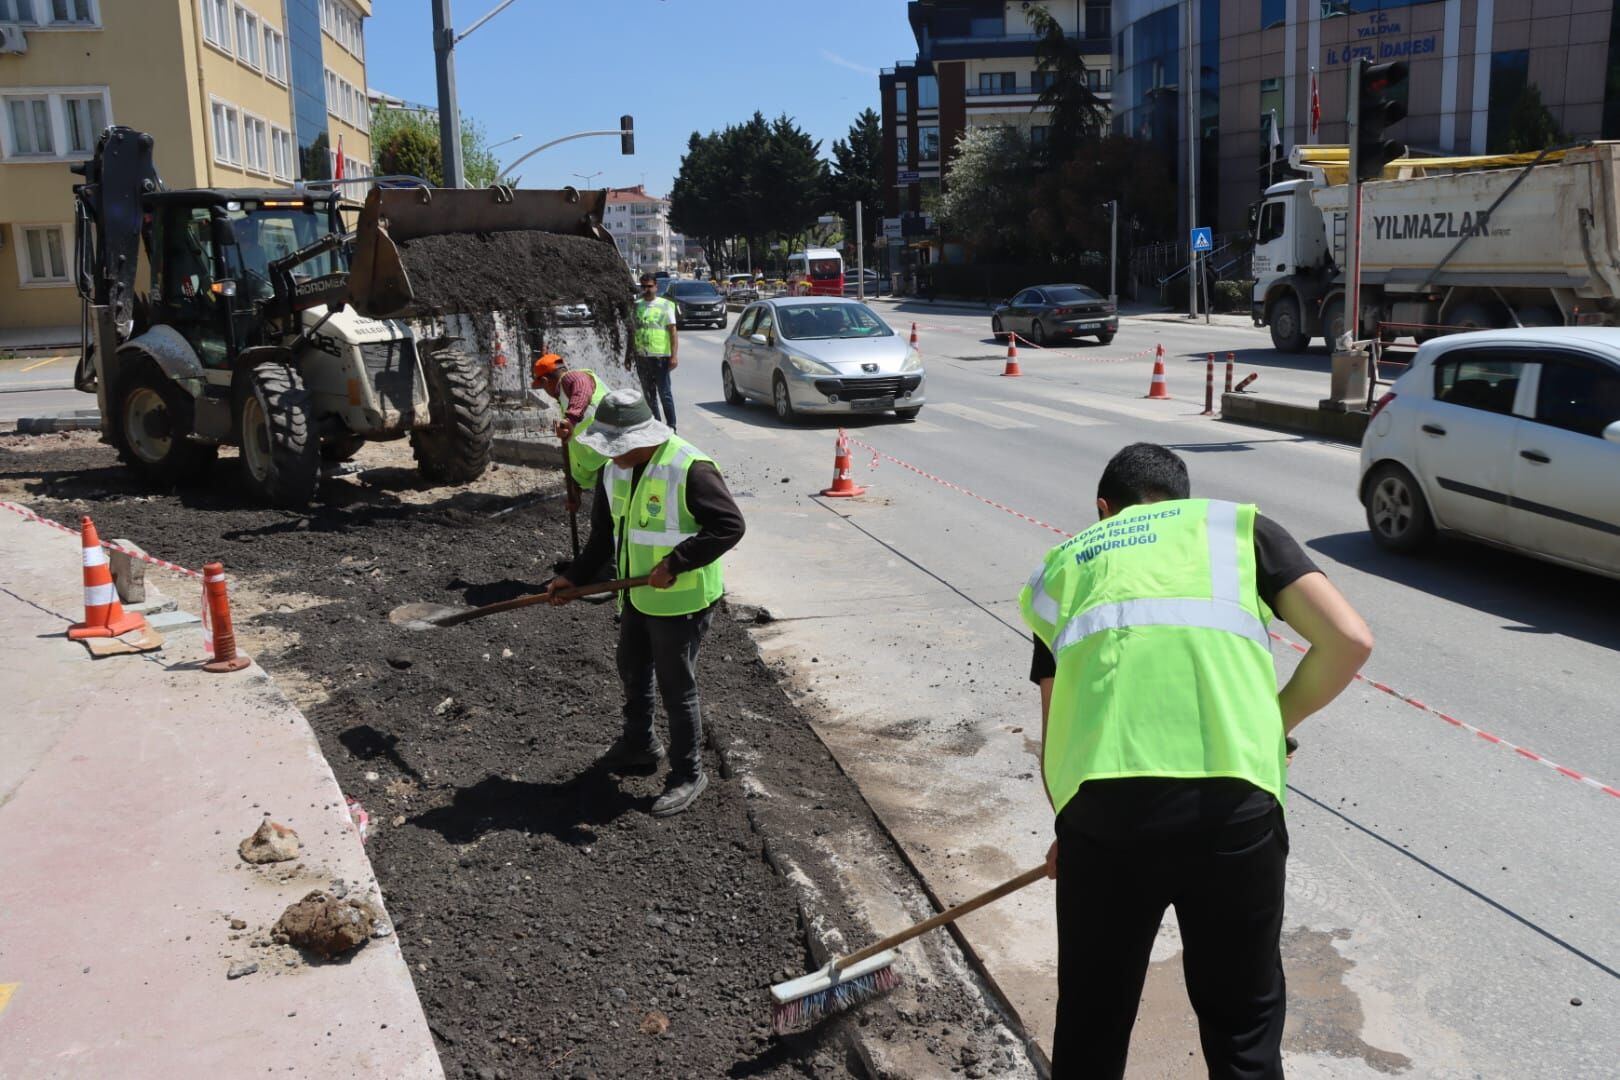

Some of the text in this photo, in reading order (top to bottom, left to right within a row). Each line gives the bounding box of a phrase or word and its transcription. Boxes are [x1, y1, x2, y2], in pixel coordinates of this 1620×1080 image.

[1357, 23, 1401, 38] YALOVA
[1326, 35, 1435, 65] İL ÖZEL İDARESİ
[1373, 210, 1490, 240] YILMAZLAR
[1060, 508, 1181, 551] YALOVA BELEDİYESİ
[1083, 532, 1106, 547] FEN
[1075, 533, 1158, 565] MÜDÜRLÜĞÜ
